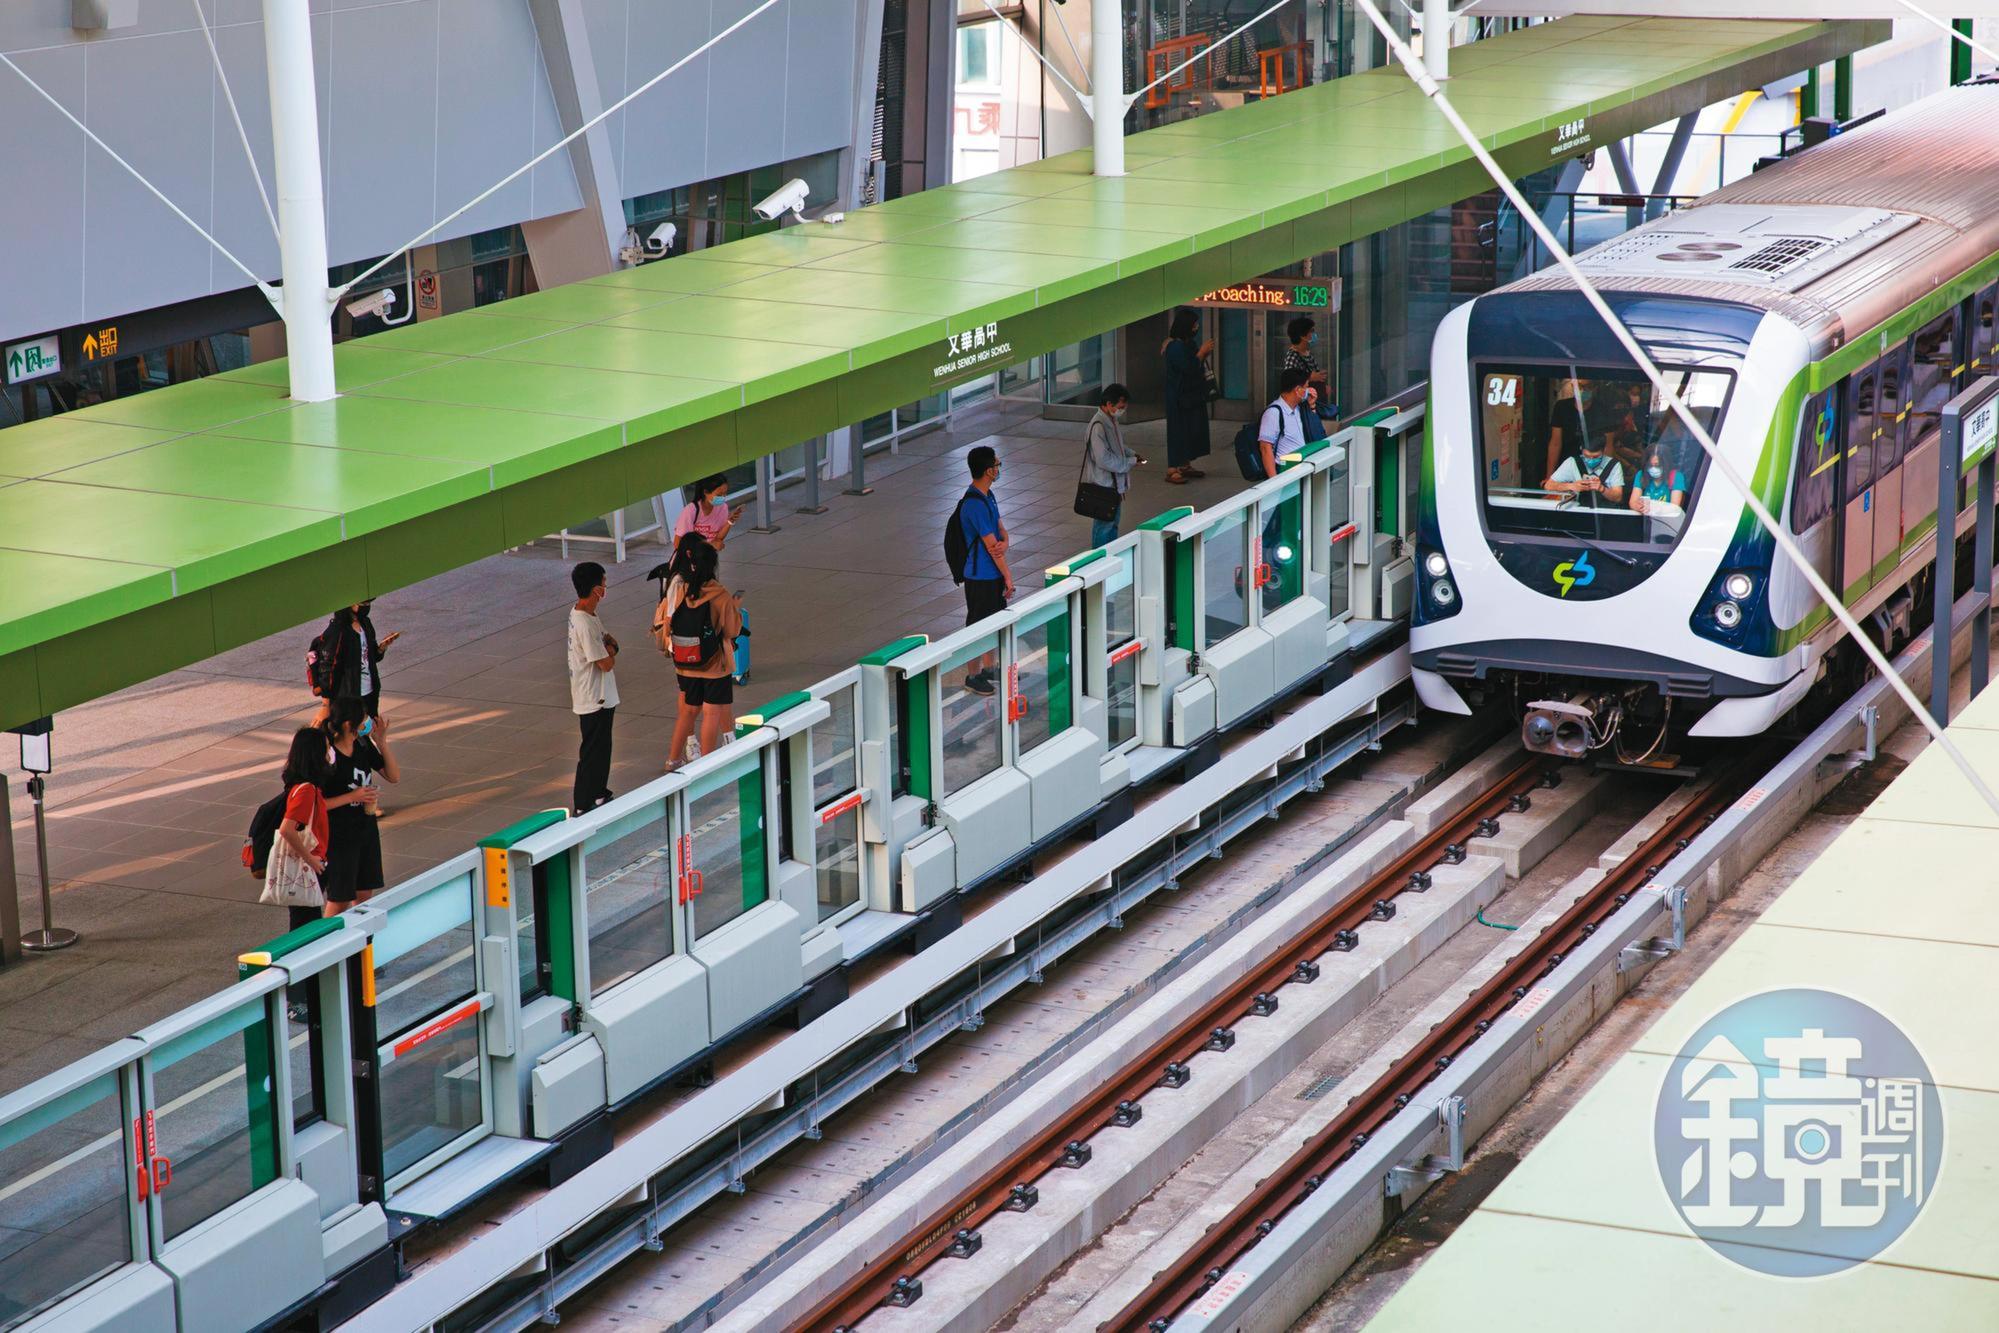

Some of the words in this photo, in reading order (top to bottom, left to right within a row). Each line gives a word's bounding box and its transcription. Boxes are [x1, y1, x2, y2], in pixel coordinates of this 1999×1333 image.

[99, 327, 118, 346] 出口
[101, 344, 118, 358] EXIT
[947, 321, 998, 358] 文華高中
[933, 362, 957, 377] WENHUA
[957, 354, 976, 369] SENIOR
[977, 350, 990, 363] HIGH
[991, 342, 1011, 358] SCHOOL
[1487, 377, 1517, 406] 34
